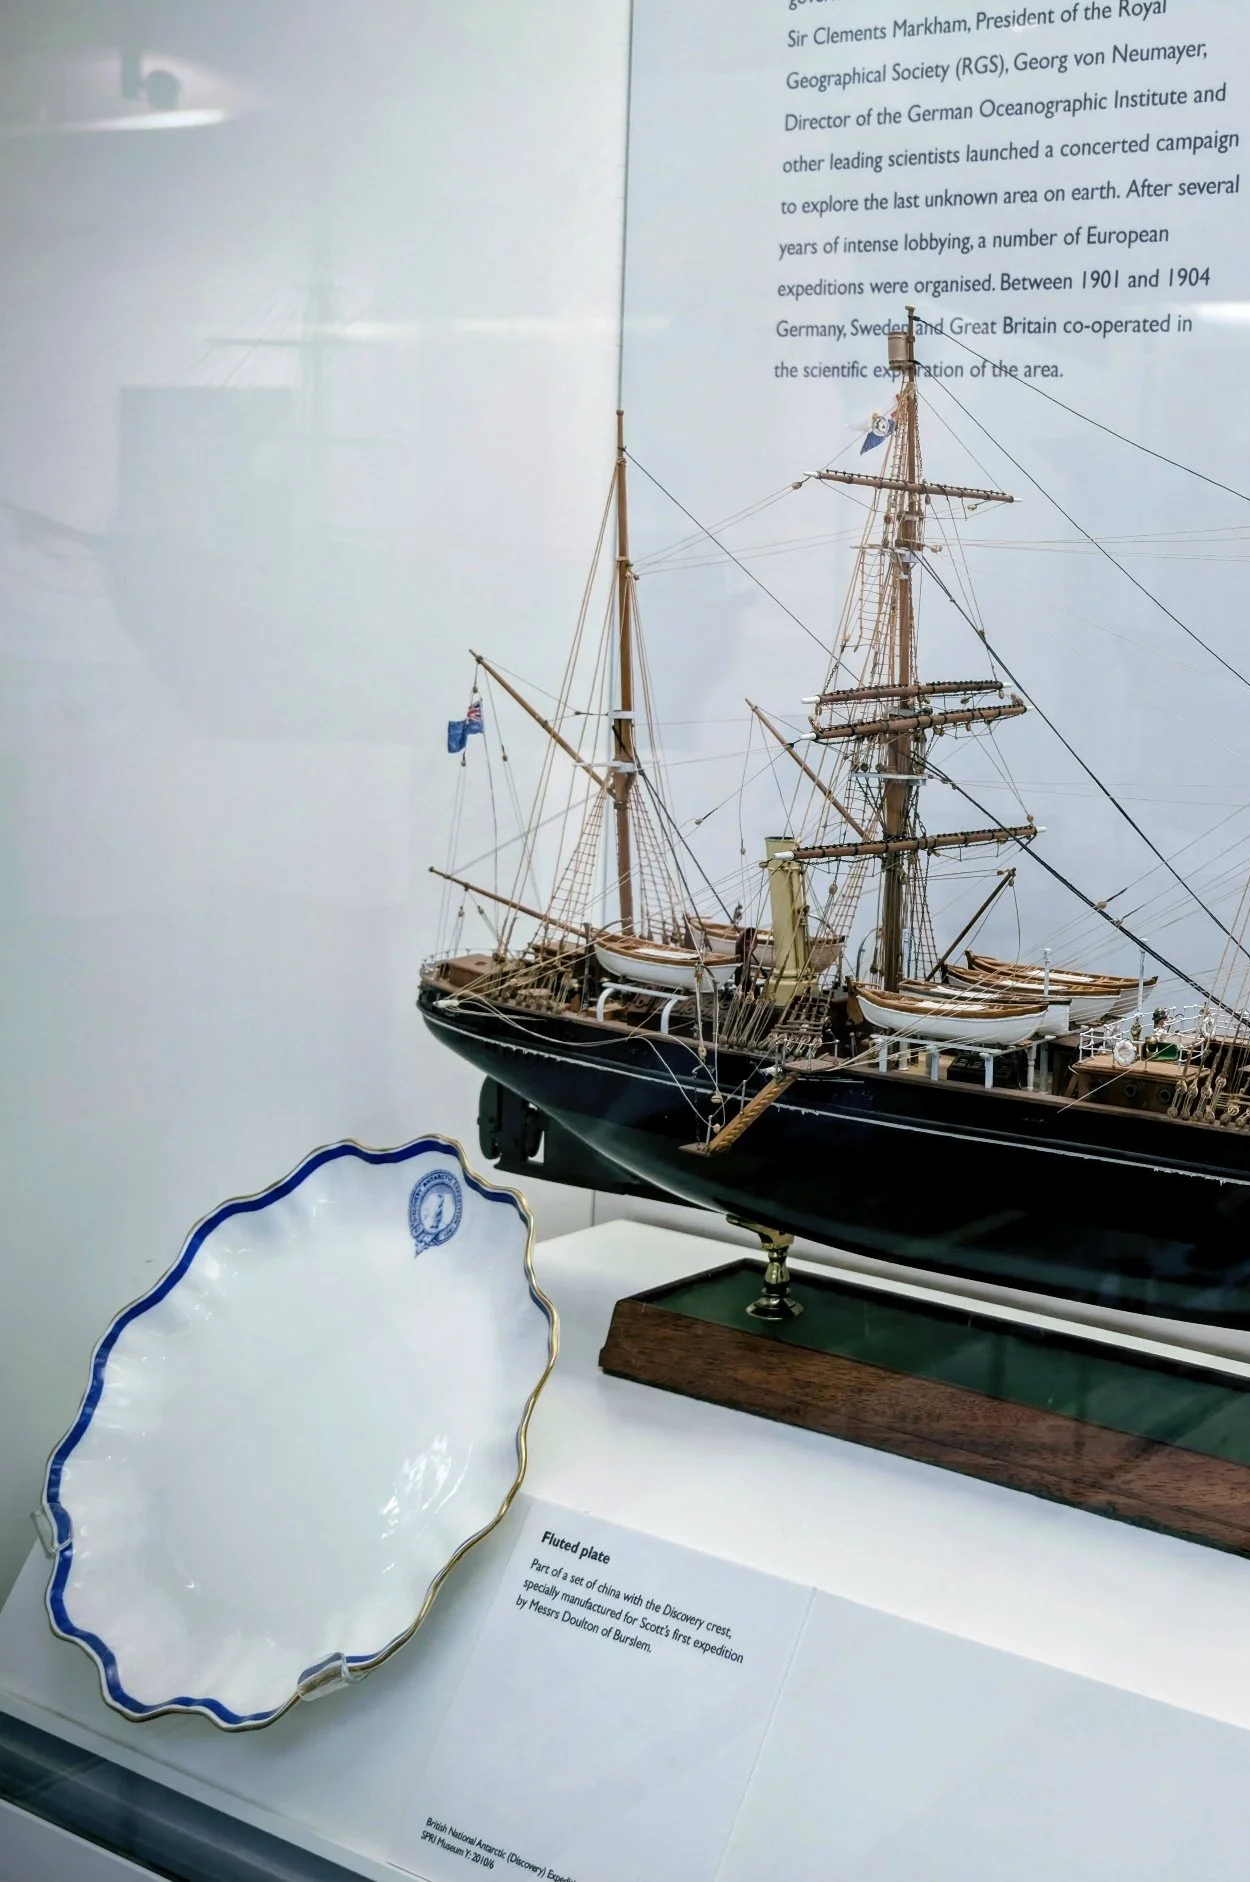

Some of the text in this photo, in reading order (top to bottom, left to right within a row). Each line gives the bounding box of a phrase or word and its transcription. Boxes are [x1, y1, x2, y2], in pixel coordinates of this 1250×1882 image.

[787, 0, 1167, 48] Sir Clements Markham, President of the Royal
[777, 266, 1211, 301] expeditions were organised. Between 1901 and 1904
[776, 313, 1192, 342] Germany, Sweden and Great Britain co-operated in
[774, 360, 1065, 382] the scientific expration of the area.
[423, 1174, 453, 1188] ANTARCTIC
[541, 1530, 610, 1565] Fluted plate
[530, 1558, 732, 1640] Part of a set of china with the Discovery crest,
[515, 1594, 652, 1653] by Messrs Doulton of Burslem.
[523, 1579, 561, 1601] specially
[560, 1592, 624, 1621] manufactured
[623, 1611, 639, 1626] for
[671, 1628, 692, 1646] first
[692, 1639, 744, 1664] expedition
[420, 1830, 495, 1870] SPRI Museum Y: 2010/6
[426, 1817, 449, 1834] British
[447, 1826, 477, 1846] National
[475, 1839, 507, 1859] Antarctic
[506, 1852, 547, 1878] (Discovery)
